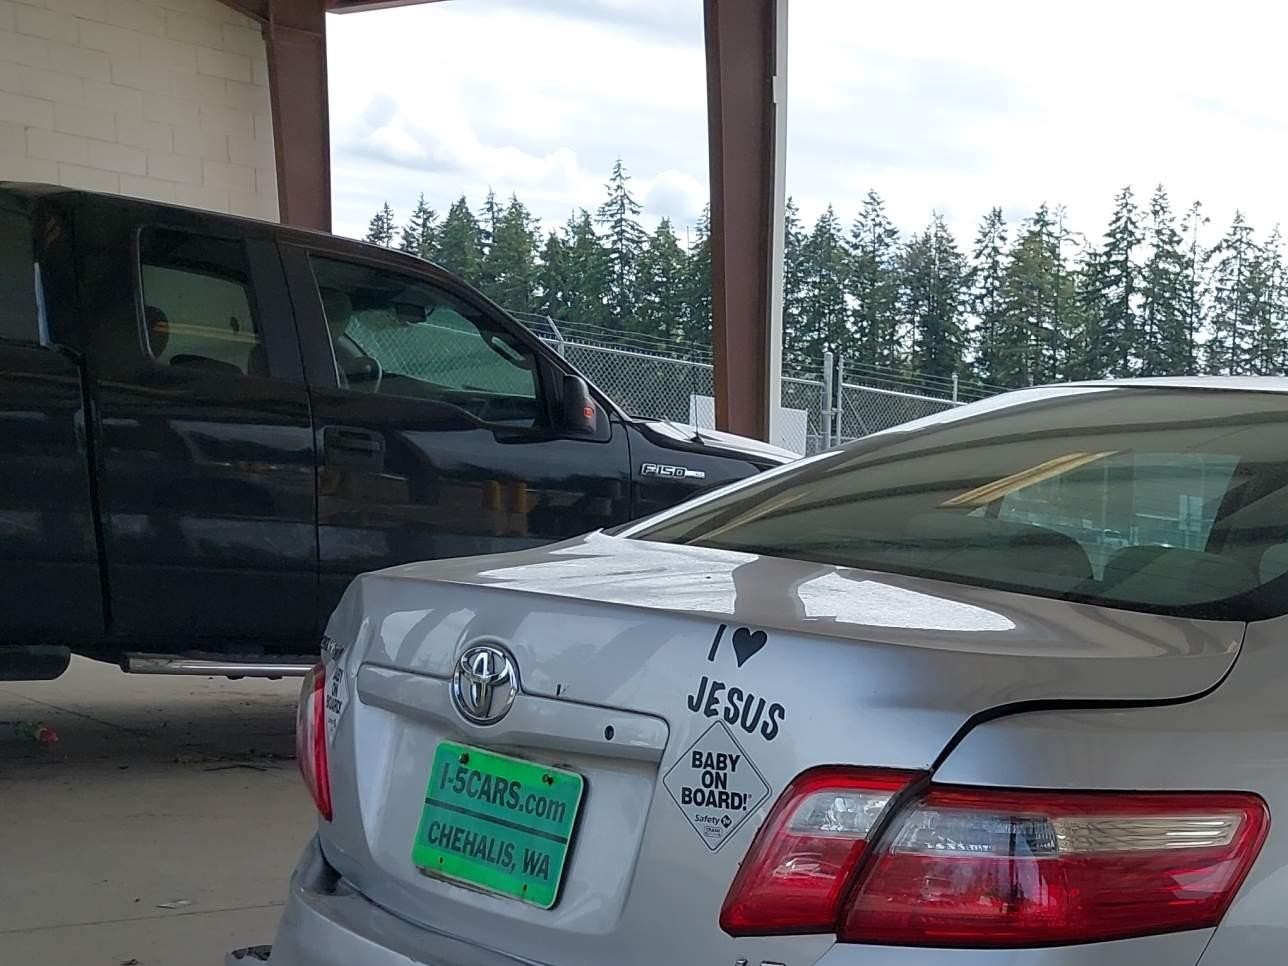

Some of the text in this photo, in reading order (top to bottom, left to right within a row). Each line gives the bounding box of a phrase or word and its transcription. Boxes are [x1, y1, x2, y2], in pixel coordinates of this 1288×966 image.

[707, 624, 727, 661] I
[688, 676, 785, 741] JESUS
[692, 751, 741, 772] BABY
[439, 762, 566, 823] I-5CARS.com
[701, 770, 727, 790] ON
[681, 787, 748, 811] BOARD!
[694, 814, 720, 826] Safety
[428, 821, 550, 880] CHEHALIS, WA
